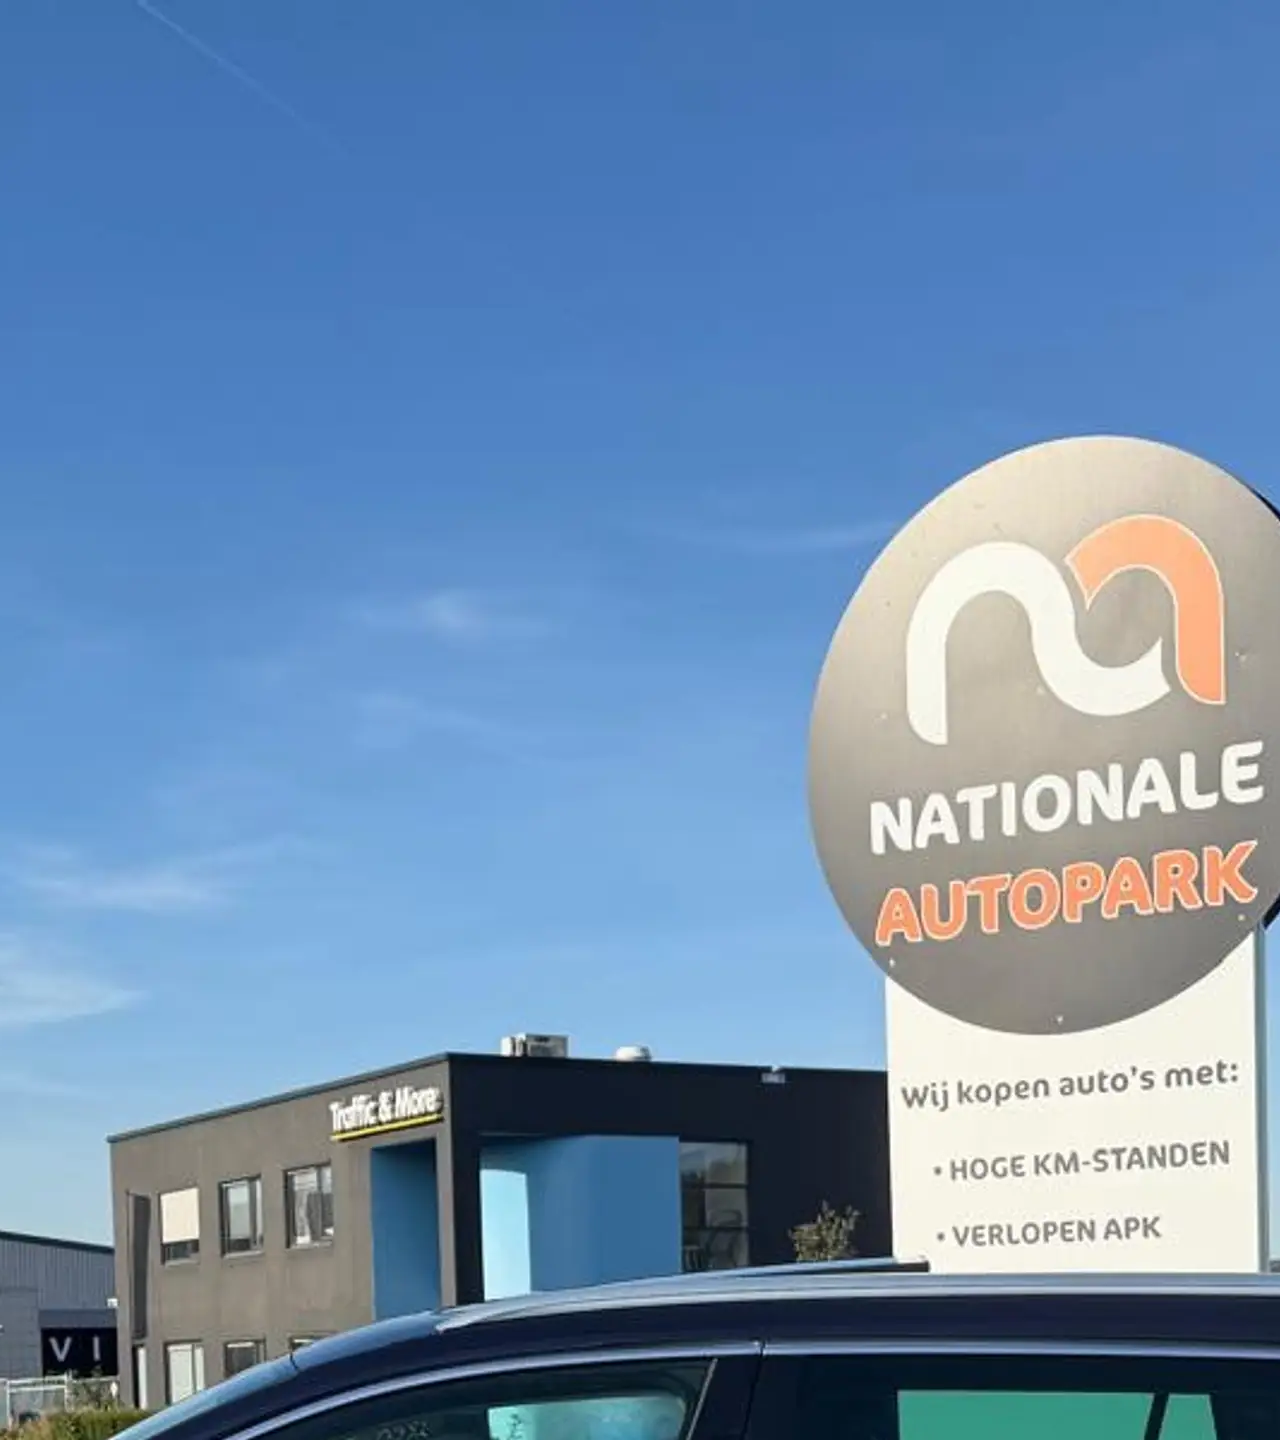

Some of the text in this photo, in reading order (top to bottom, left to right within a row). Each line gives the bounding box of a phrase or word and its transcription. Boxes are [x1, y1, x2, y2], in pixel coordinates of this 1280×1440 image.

[869, 740, 1265, 855] NATIONALE
[875, 840, 1258, 947] AUTOPARK
[328, 1085, 440, 1132] Traffic & More
[900, 1059, 1239, 1113] Wij kopen auto's met:
[949, 1140, 1231, 1182] HOGE KM-STANDEN
[952, 1215, 1163, 1248] VERLOPEN APK
